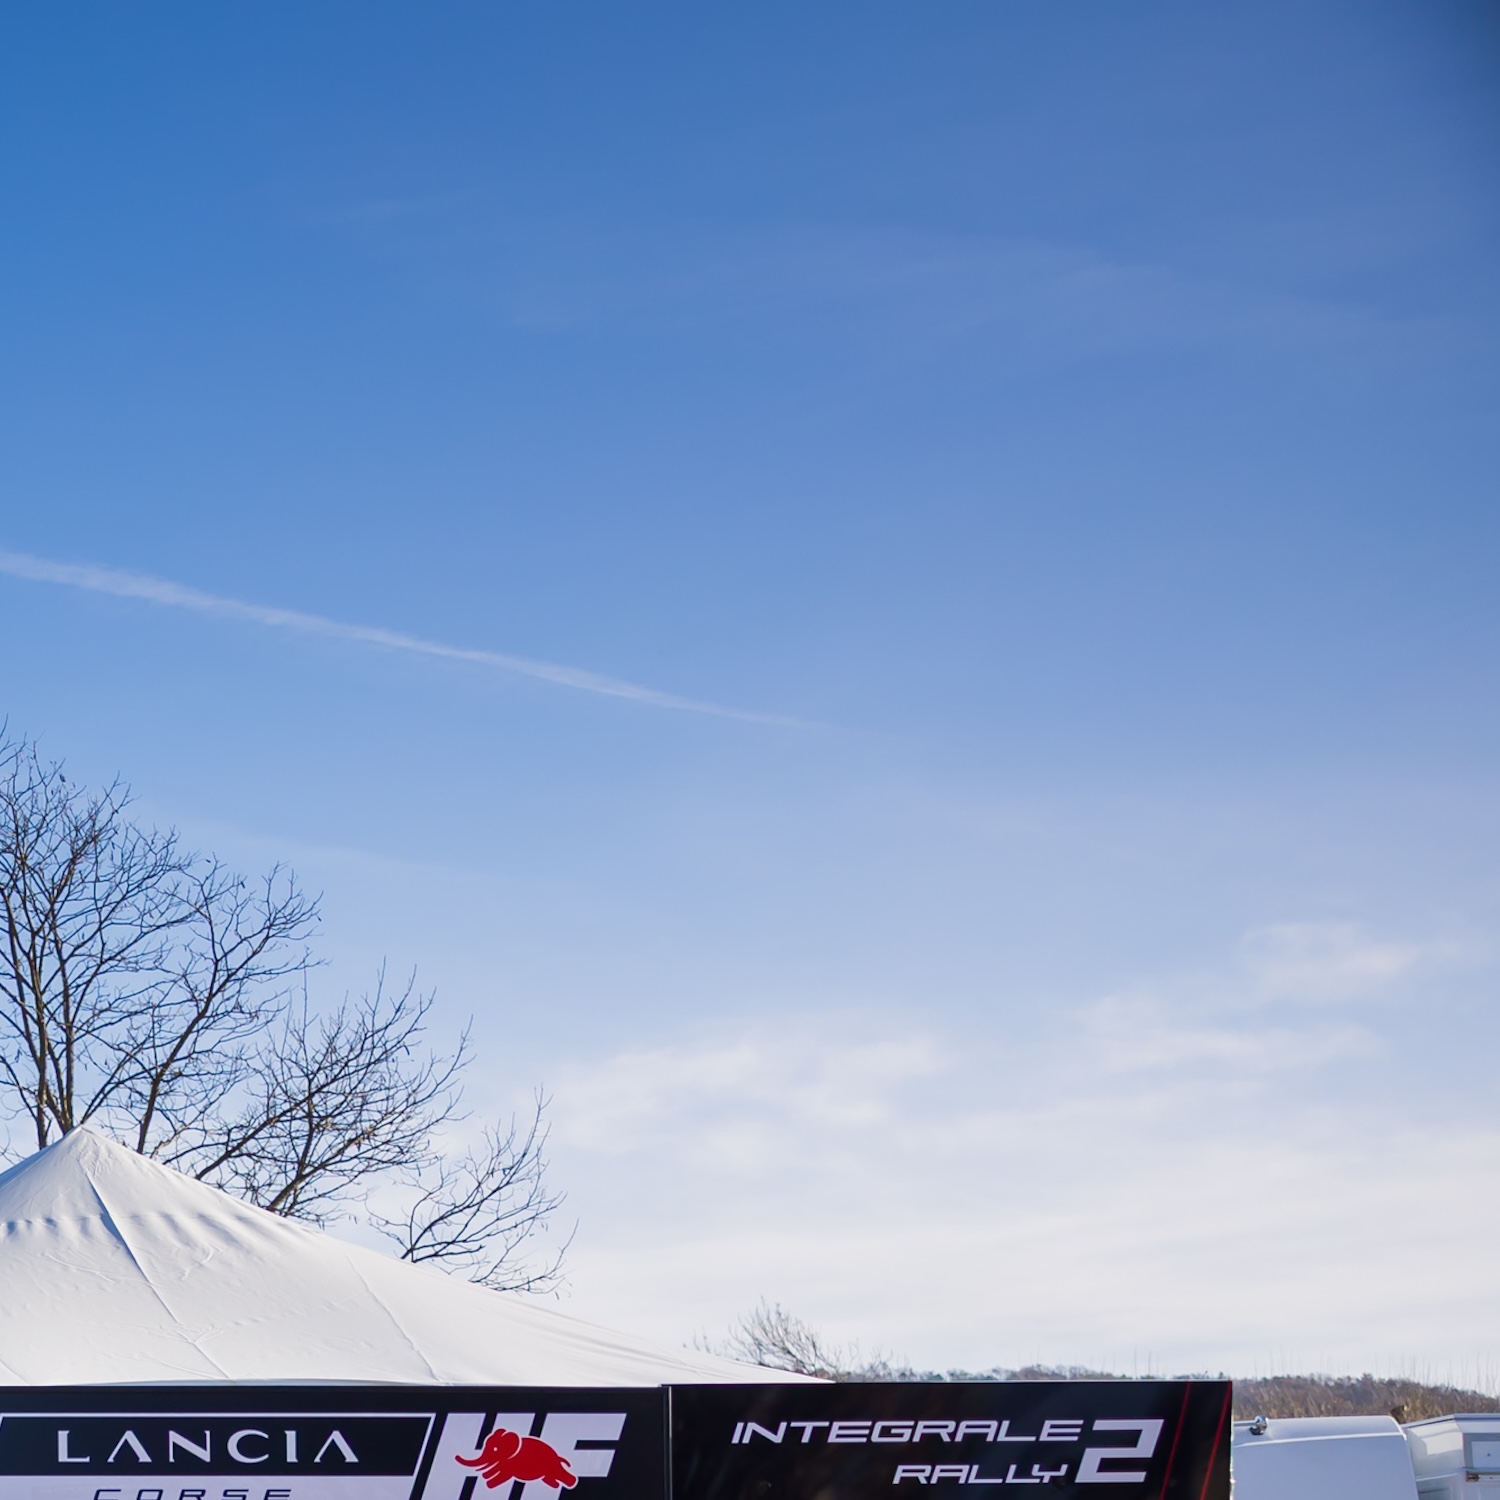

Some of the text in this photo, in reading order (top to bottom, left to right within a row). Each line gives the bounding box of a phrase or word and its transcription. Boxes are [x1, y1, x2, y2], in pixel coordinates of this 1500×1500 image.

[56, 1429, 360, 1465] LANCIA
[731, 1419, 1166, 1484] INTEGRALE 2
[892, 1463, 1069, 1486] RALLY
